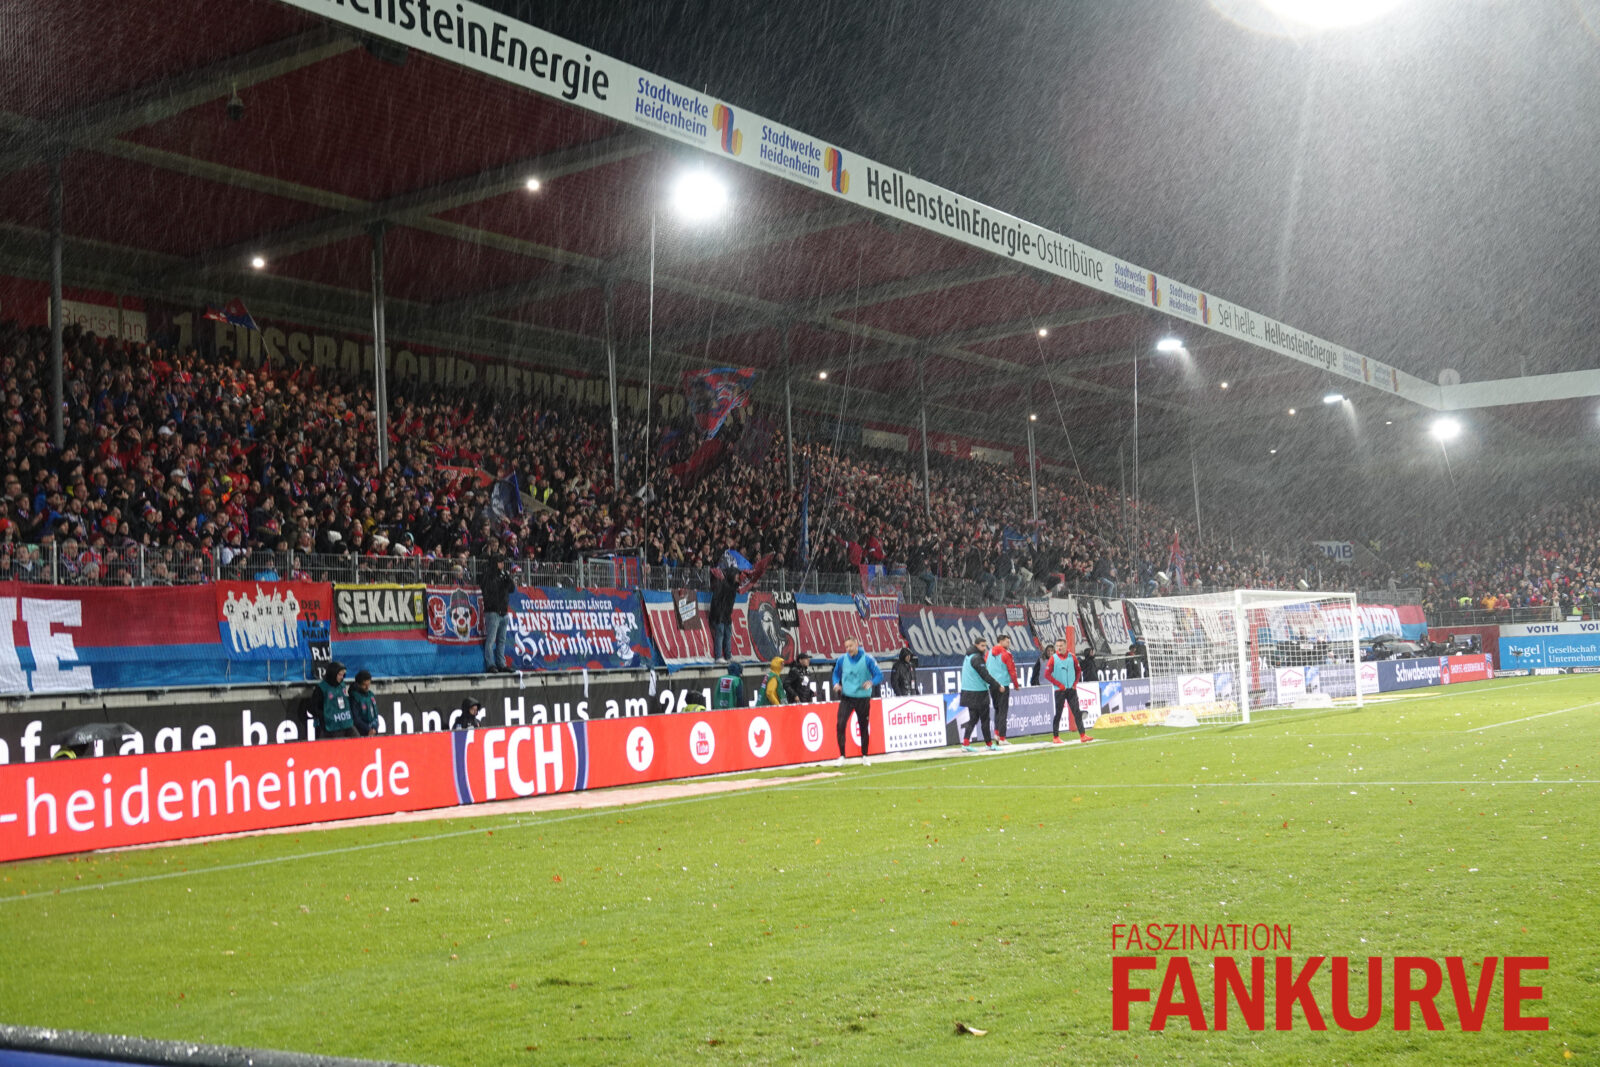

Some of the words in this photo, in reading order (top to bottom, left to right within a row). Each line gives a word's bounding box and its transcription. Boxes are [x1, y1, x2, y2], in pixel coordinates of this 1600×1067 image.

[328, 0, 610, 101] nsteinEnergie
[637, 76, 709, 118] Stadtwerke
[635, 97, 708, 137] Heidenheim
[761, 125, 822, 161] Stadtwerke
[760, 143, 820, 179] Heidenheim
[1114, 263, 1146, 285] Stadtwerke
[1114, 277, 1146, 297] Heidenheim
[1169, 284, 1198, 304] Stadtwerke
[62, 305, 147, 337] Bierschn
[1218, 303, 1232, 328] Sei
[1264, 321, 1338, 369] HellensteinEnergie
[301, 600, 321, 610] DER
[520, 599, 564, 611] TOTGESAGTE
[564, 599, 587, 611] LEBEN
[586, 597, 613, 611] LÄNGER
[1526, 625, 1559, 634] VOITH
[1547, 644, 1597, 655] Gesellschaft
[1020, 693, 1050, 705] INDUSTRIEBAU
[503, 696, 589, 727] Haus
[604, 697, 649, 719] am
[891, 711, 938, 728] dörflinger
[889, 731, 942, 741] BEDACHUNGEN
[889, 739, 943, 749] FASSADENBAU
[483, 723, 564, 800] FCH
